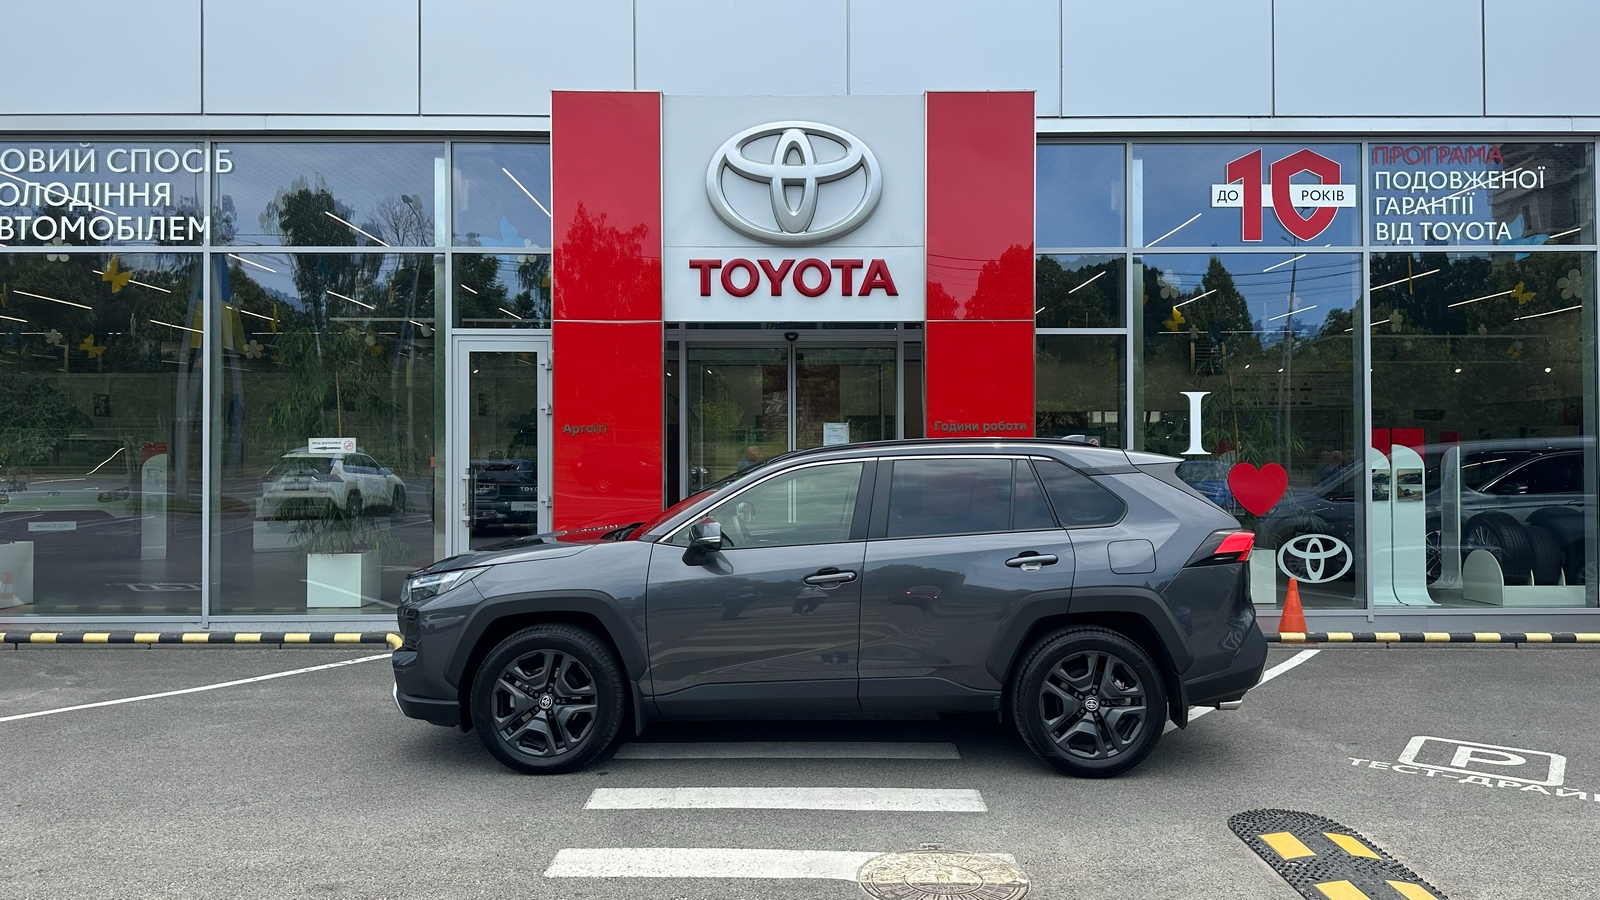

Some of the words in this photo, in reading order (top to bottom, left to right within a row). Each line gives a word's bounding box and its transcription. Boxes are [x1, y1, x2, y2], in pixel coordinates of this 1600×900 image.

[0, 142, 95, 173] ОВИЙ
[106, 148, 233, 173] СПОСІБ
[1373, 145, 1504, 164] ПРОГРАМА
[1375, 166, 1546, 193] ПОДОВЖЕНОЇ
[0, 182, 170, 211] ОЛОДІННЯ
[1216, 190, 1239, 203] ДО
[1226, 147, 1342, 241] 10
[1301, 190, 1345, 201] РОКІВ
[1375, 192, 1476, 215] ГАРАНТІЇ
[0, 216, 210, 241] ВТОМОБІЛЕМ
[1376, 222, 1414, 244] ВІД
[1419, 222, 1512, 240] TOYOTA
[689, 258, 899, 298] TOYOTA
[563, 423, 608, 437] Артсіті
[934, 421, 979, 433] Години
[983, 420, 1027, 434] роботи
[1348, 757, 1600, 802] ТЕСТ-ДРАЙ
